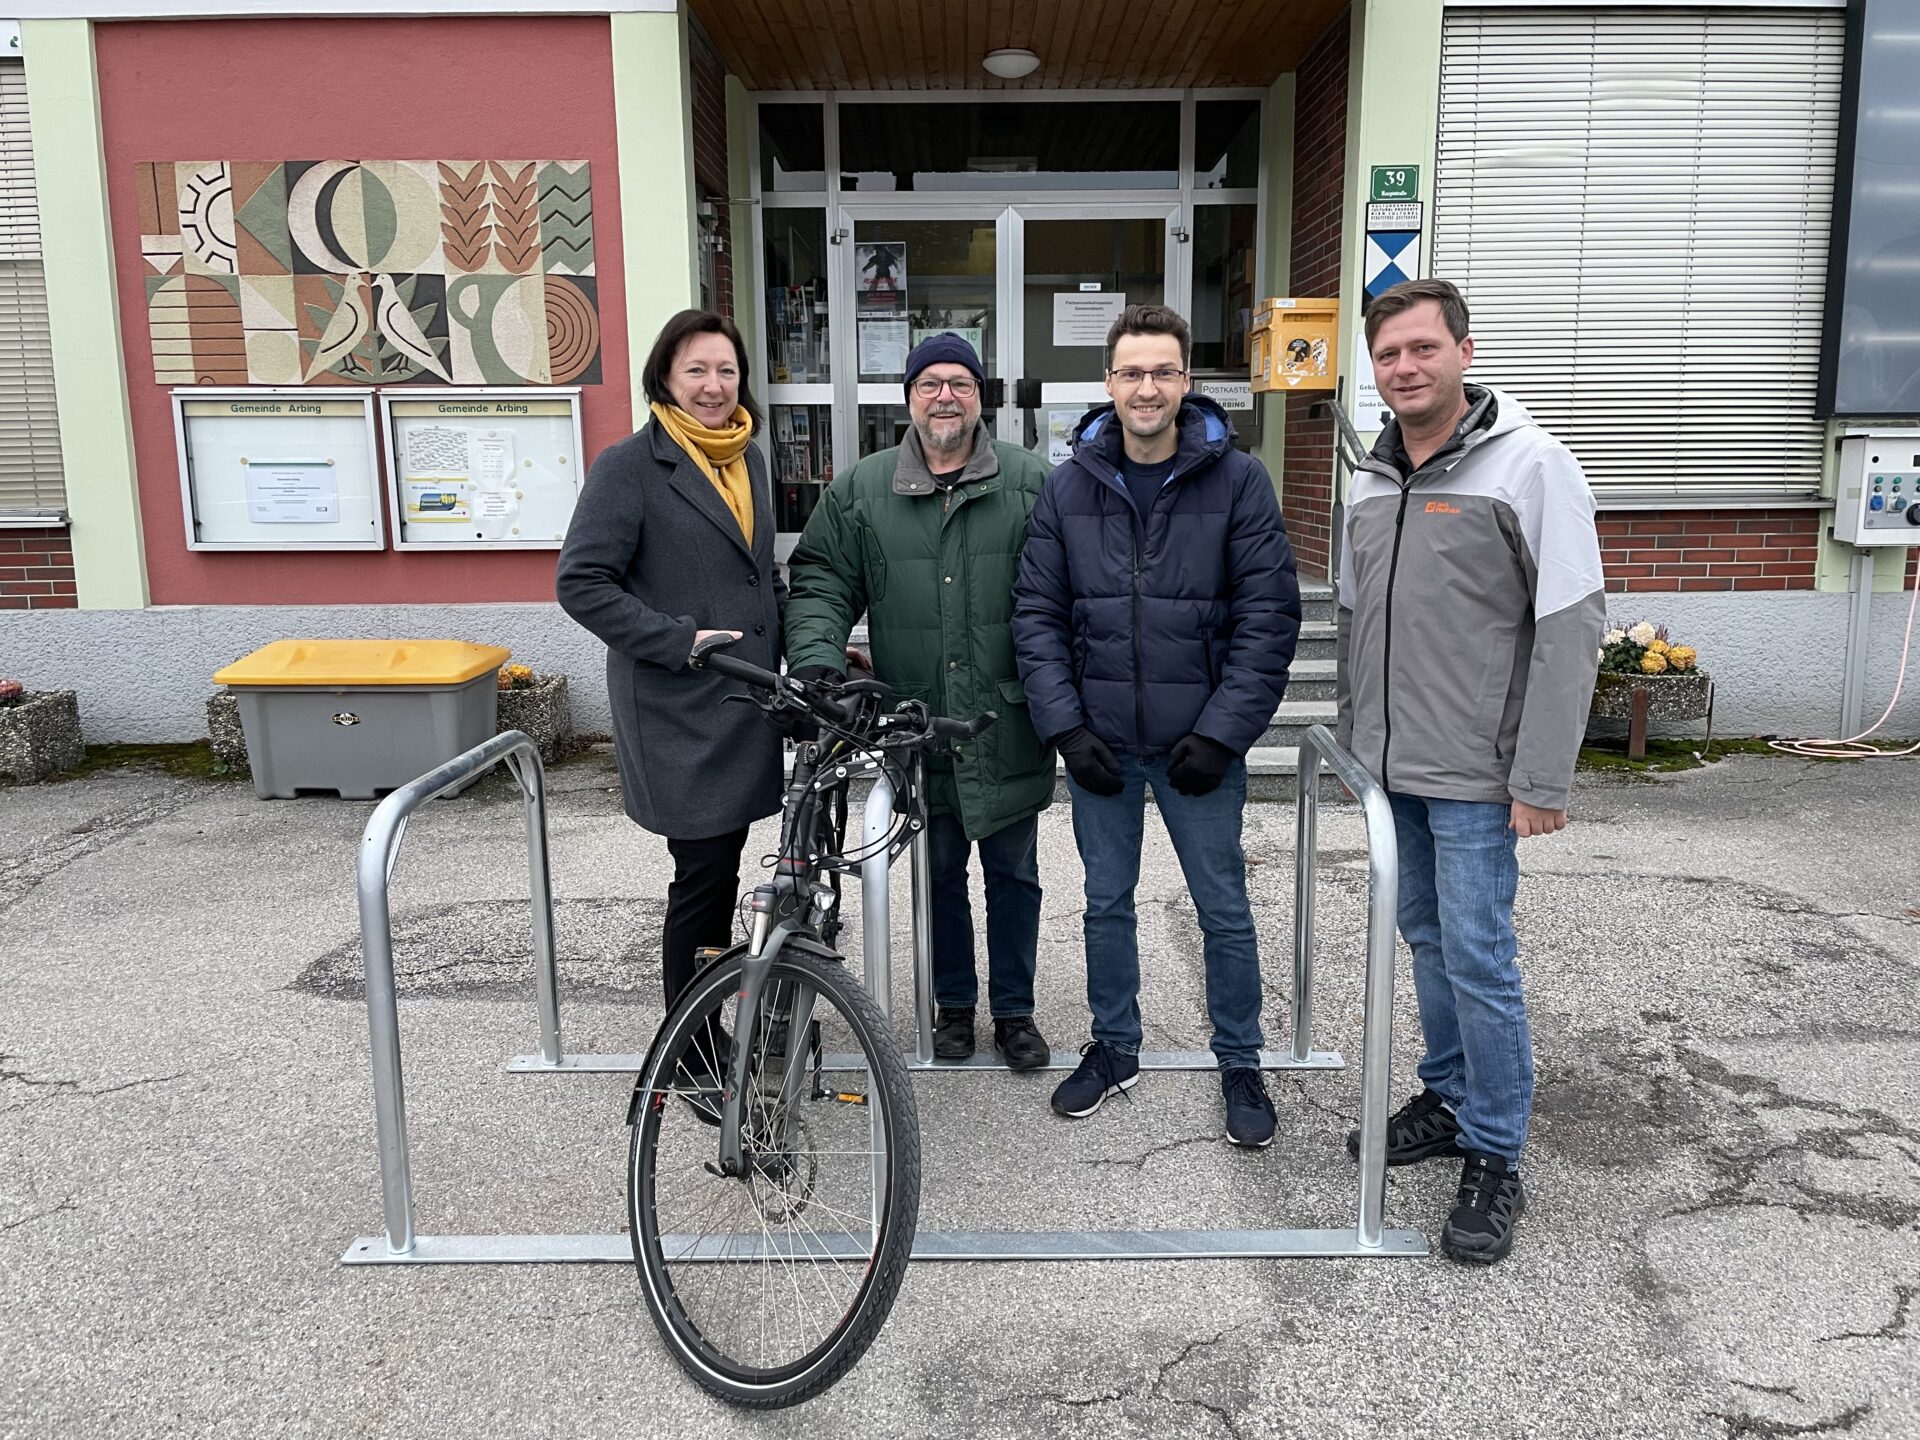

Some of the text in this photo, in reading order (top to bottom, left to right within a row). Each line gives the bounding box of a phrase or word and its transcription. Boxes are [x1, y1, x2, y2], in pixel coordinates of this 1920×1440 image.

[1384, 171, 1406, 186] 39
[1203, 385, 1253, 394] POSTKASTEN
[230, 403, 322, 415] Gemeinde Arbing
[438, 403, 529, 414] Gemeinde Arbing
